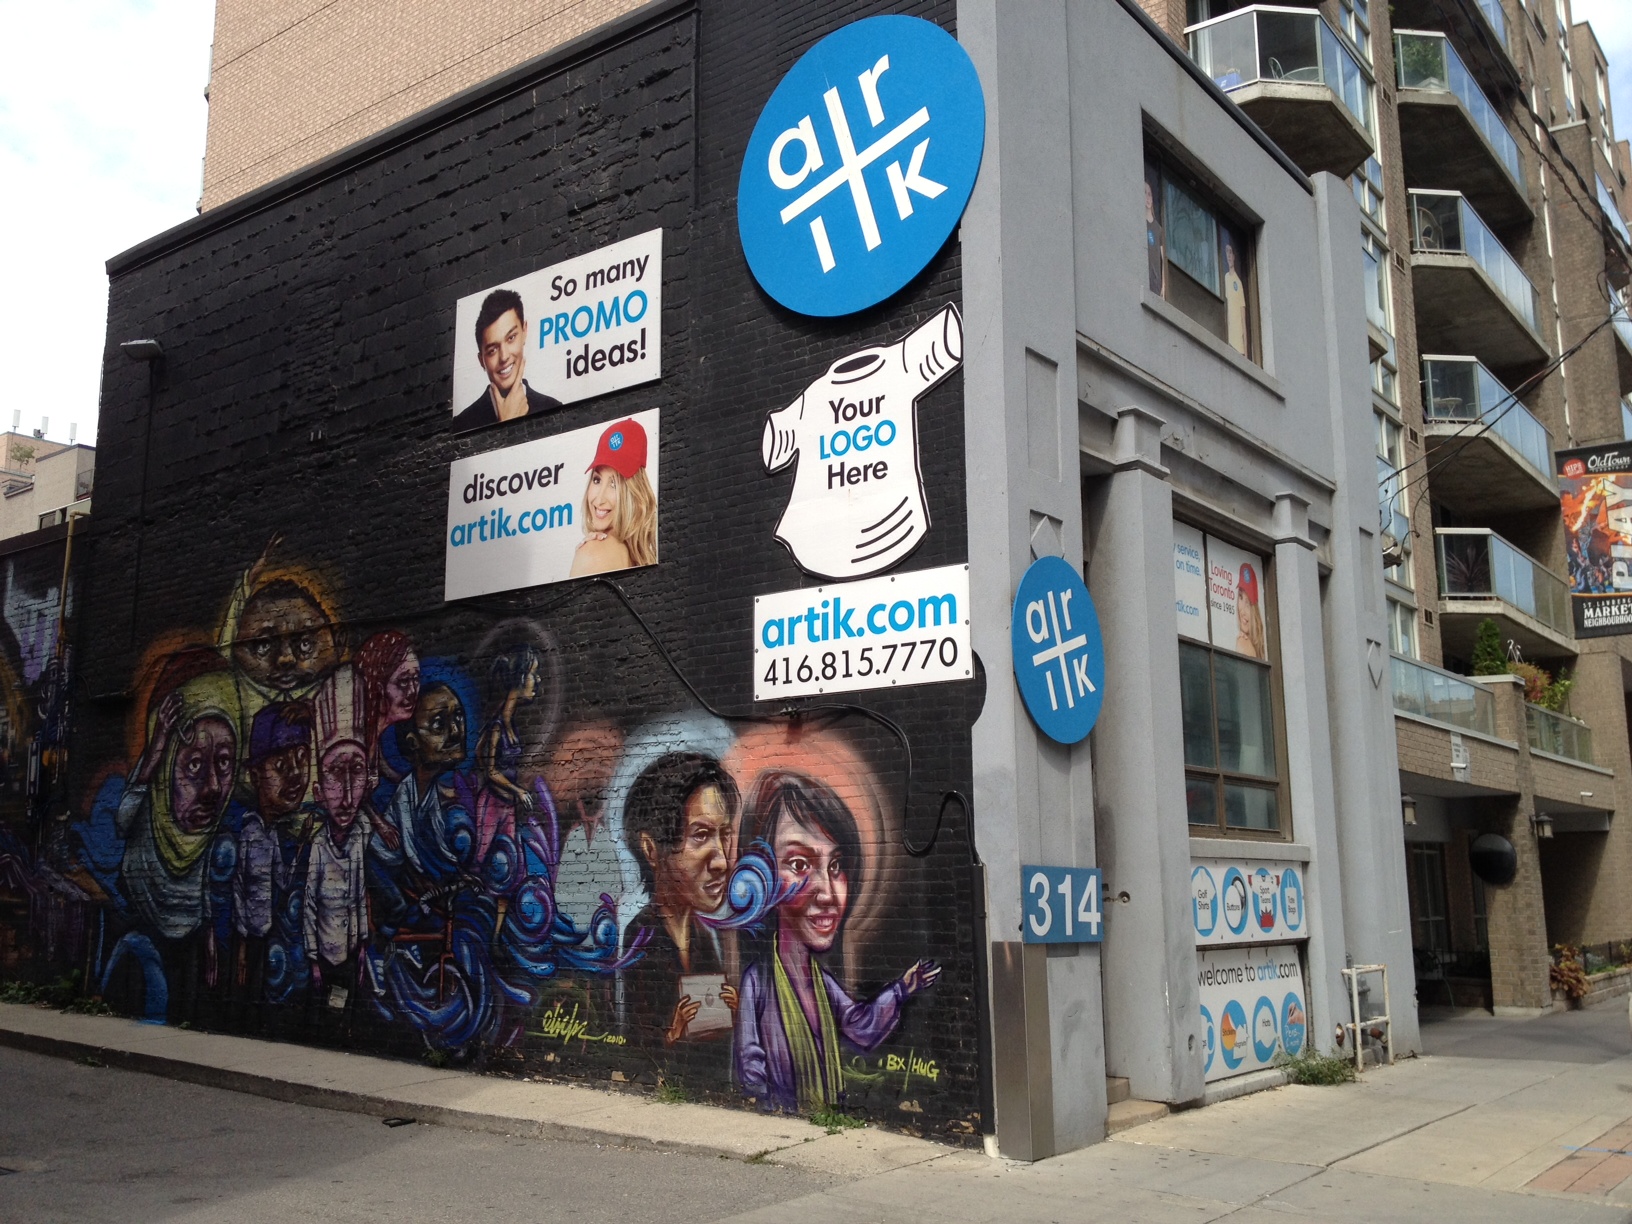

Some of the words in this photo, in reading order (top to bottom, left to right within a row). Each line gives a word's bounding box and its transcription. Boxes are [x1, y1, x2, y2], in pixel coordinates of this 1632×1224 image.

[550, 275, 578, 302] So
[585, 254, 650, 292] many
[539, 289, 648, 350] PROMO
[565, 327, 647, 380] ideas!
[828, 394, 886, 425] Your
[819, 419, 897, 461] LOGO
[463, 462, 565, 504] discover
[827, 459, 889, 490] Here
[450, 502, 574, 548] artik.com
[1175, 558, 1185, 570] on
[1210, 560, 1233, 586] Loving
[1209, 577, 1235, 601] Toronto
[1596, 597, 1632, 606] LAWRENC
[761, 592, 958, 650] artik.com
[1210, 599, 1222, 611] since
[1223, 602, 1235, 615] 1985
[1583, 613, 1632, 628] NEIGHBOURHOO
[763, 636, 958, 687] 416.815.7770
[1029, 872, 1102, 936] 314
[1198, 889, 1208, 900] Golf
[1198, 901, 1210, 911] Shirts
[1226, 902, 1241, 911] Buttons
[1197, 962, 1243, 987] welcome
[1244, 963, 1256, 983] to
[1256, 957, 1299, 982] artik.com
